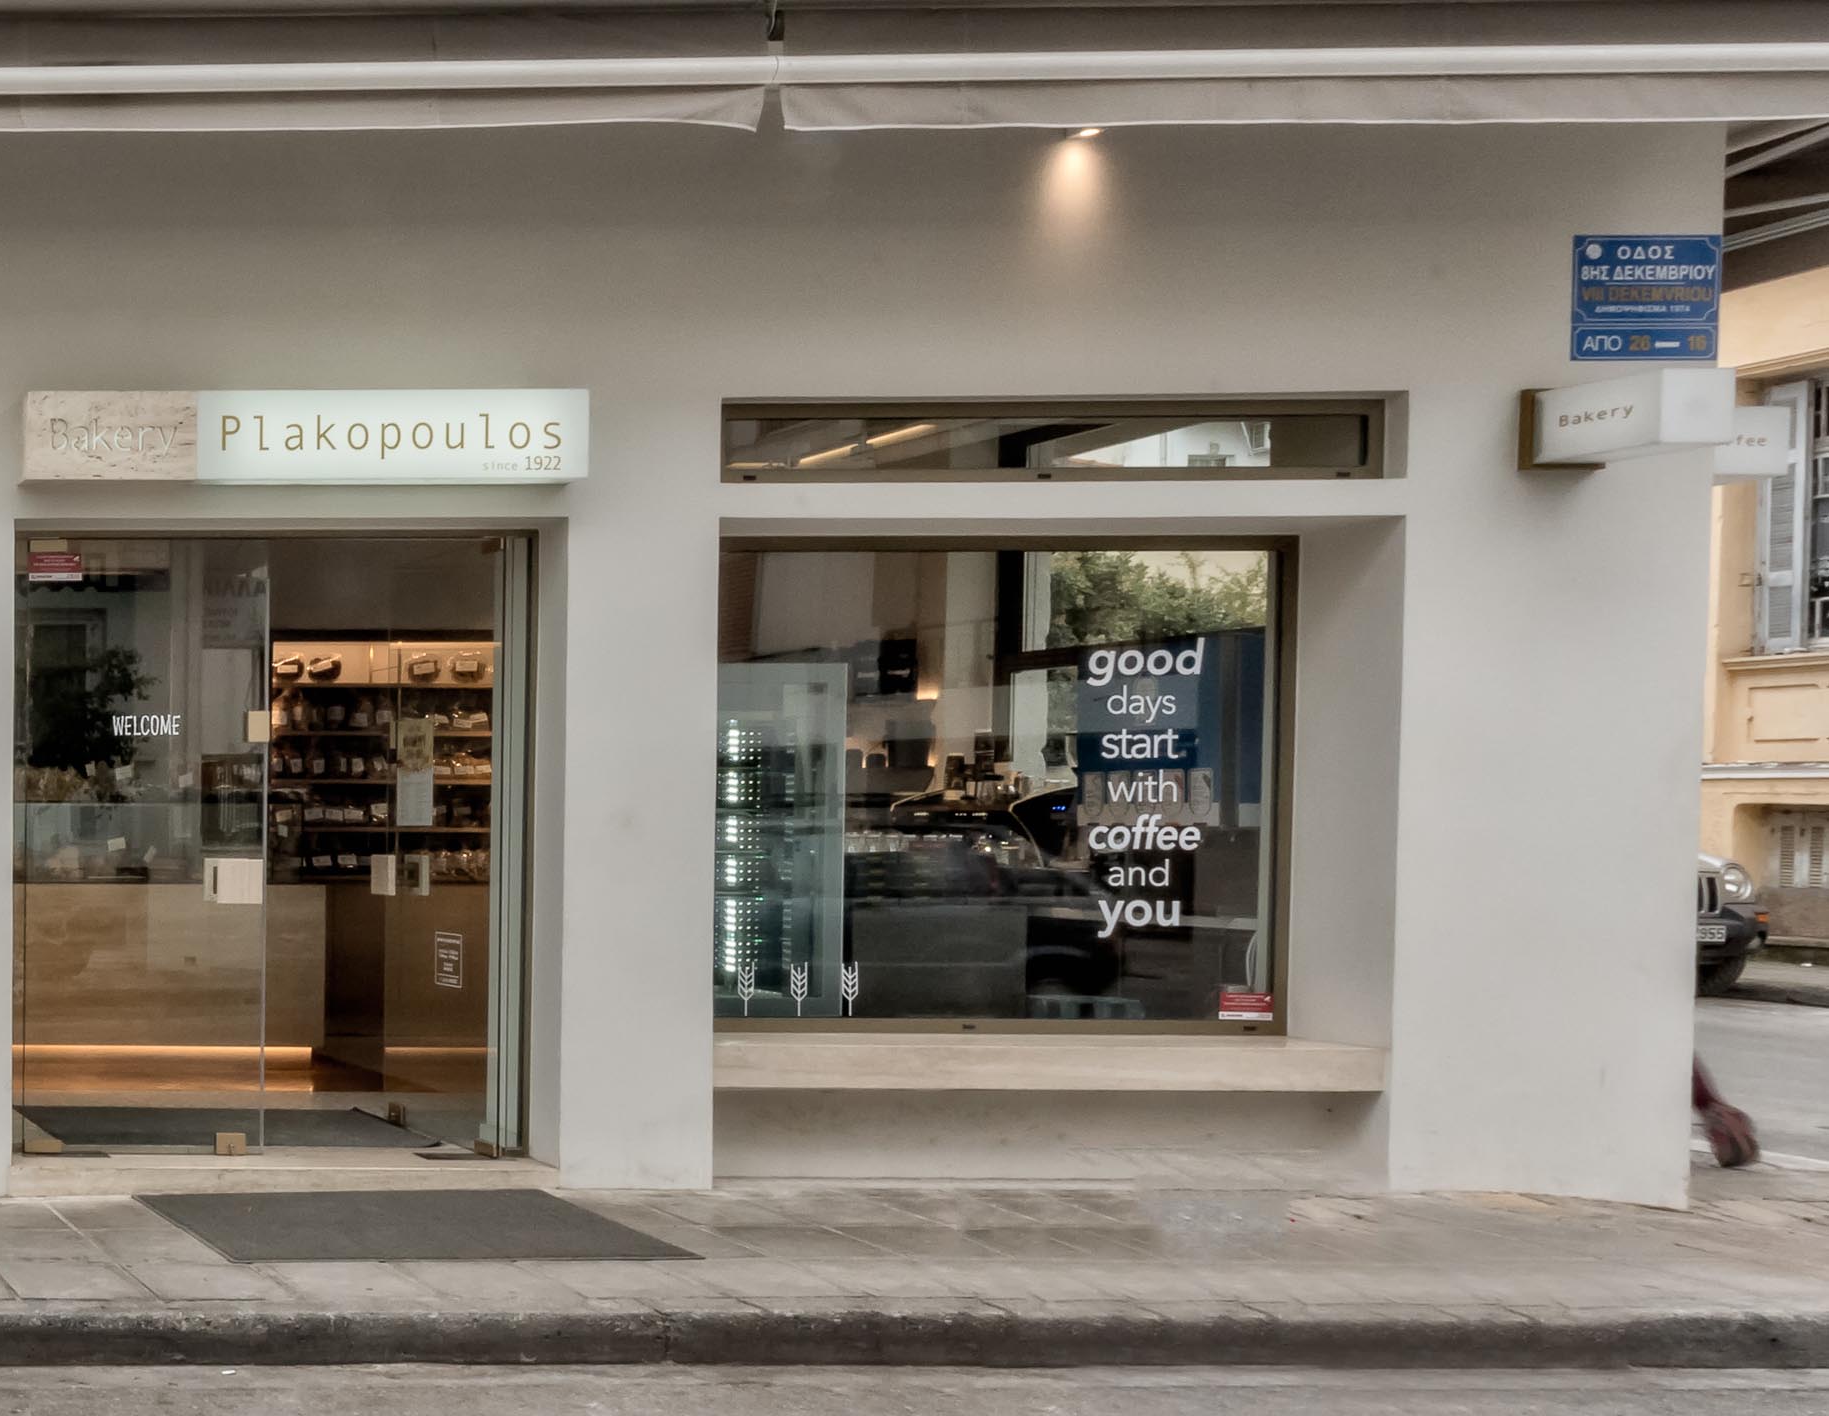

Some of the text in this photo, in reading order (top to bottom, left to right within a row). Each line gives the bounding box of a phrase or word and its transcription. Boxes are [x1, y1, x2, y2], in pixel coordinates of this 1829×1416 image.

[1617, 245, 1675, 260] ΟΔΟΣ
[1580, 265, 1717, 281] 8ΗΣ ΔΕΚΕΜΒΡΙΟΥ
[1582, 335, 1623, 352] ΑΠΟ
[1558, 403, 1634, 428] Bakery
[49, 412, 563, 460] Bakery Plakopoulos
[482, 455, 562, 471] since 1922
[1086, 637, 1205, 687] good
[1106, 684, 1177, 724] days
[112, 713, 182, 737] WELCOME
[1100, 728, 1179, 759] start
[1107, 768, 1178, 803] with
[1088, 814, 1202, 851] coffee
[1107, 858, 1170, 888] and
[1097, 899, 1182, 939] you
